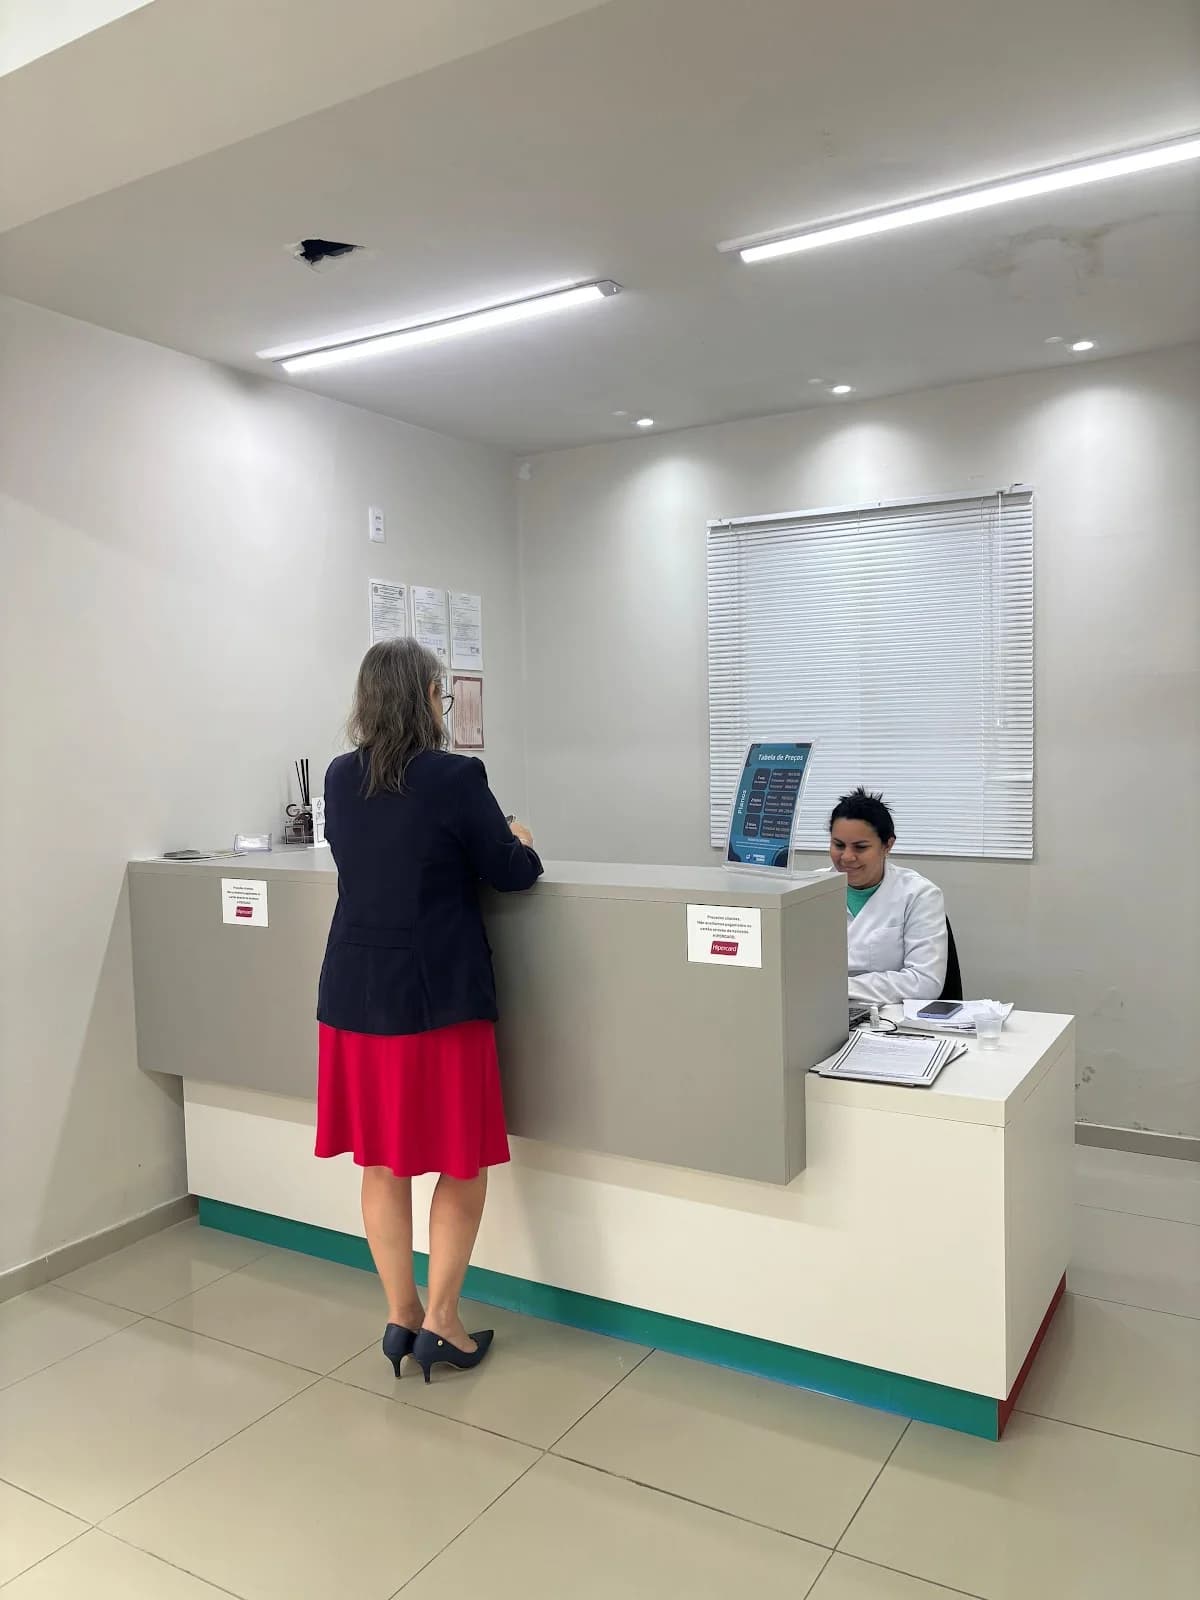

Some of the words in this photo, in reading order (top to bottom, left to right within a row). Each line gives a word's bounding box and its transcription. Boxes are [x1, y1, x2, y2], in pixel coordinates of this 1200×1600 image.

[785, 755, 803, 763] Preços
[737, 790, 747, 814] Planos
[712, 944, 737, 952] Hipercard
